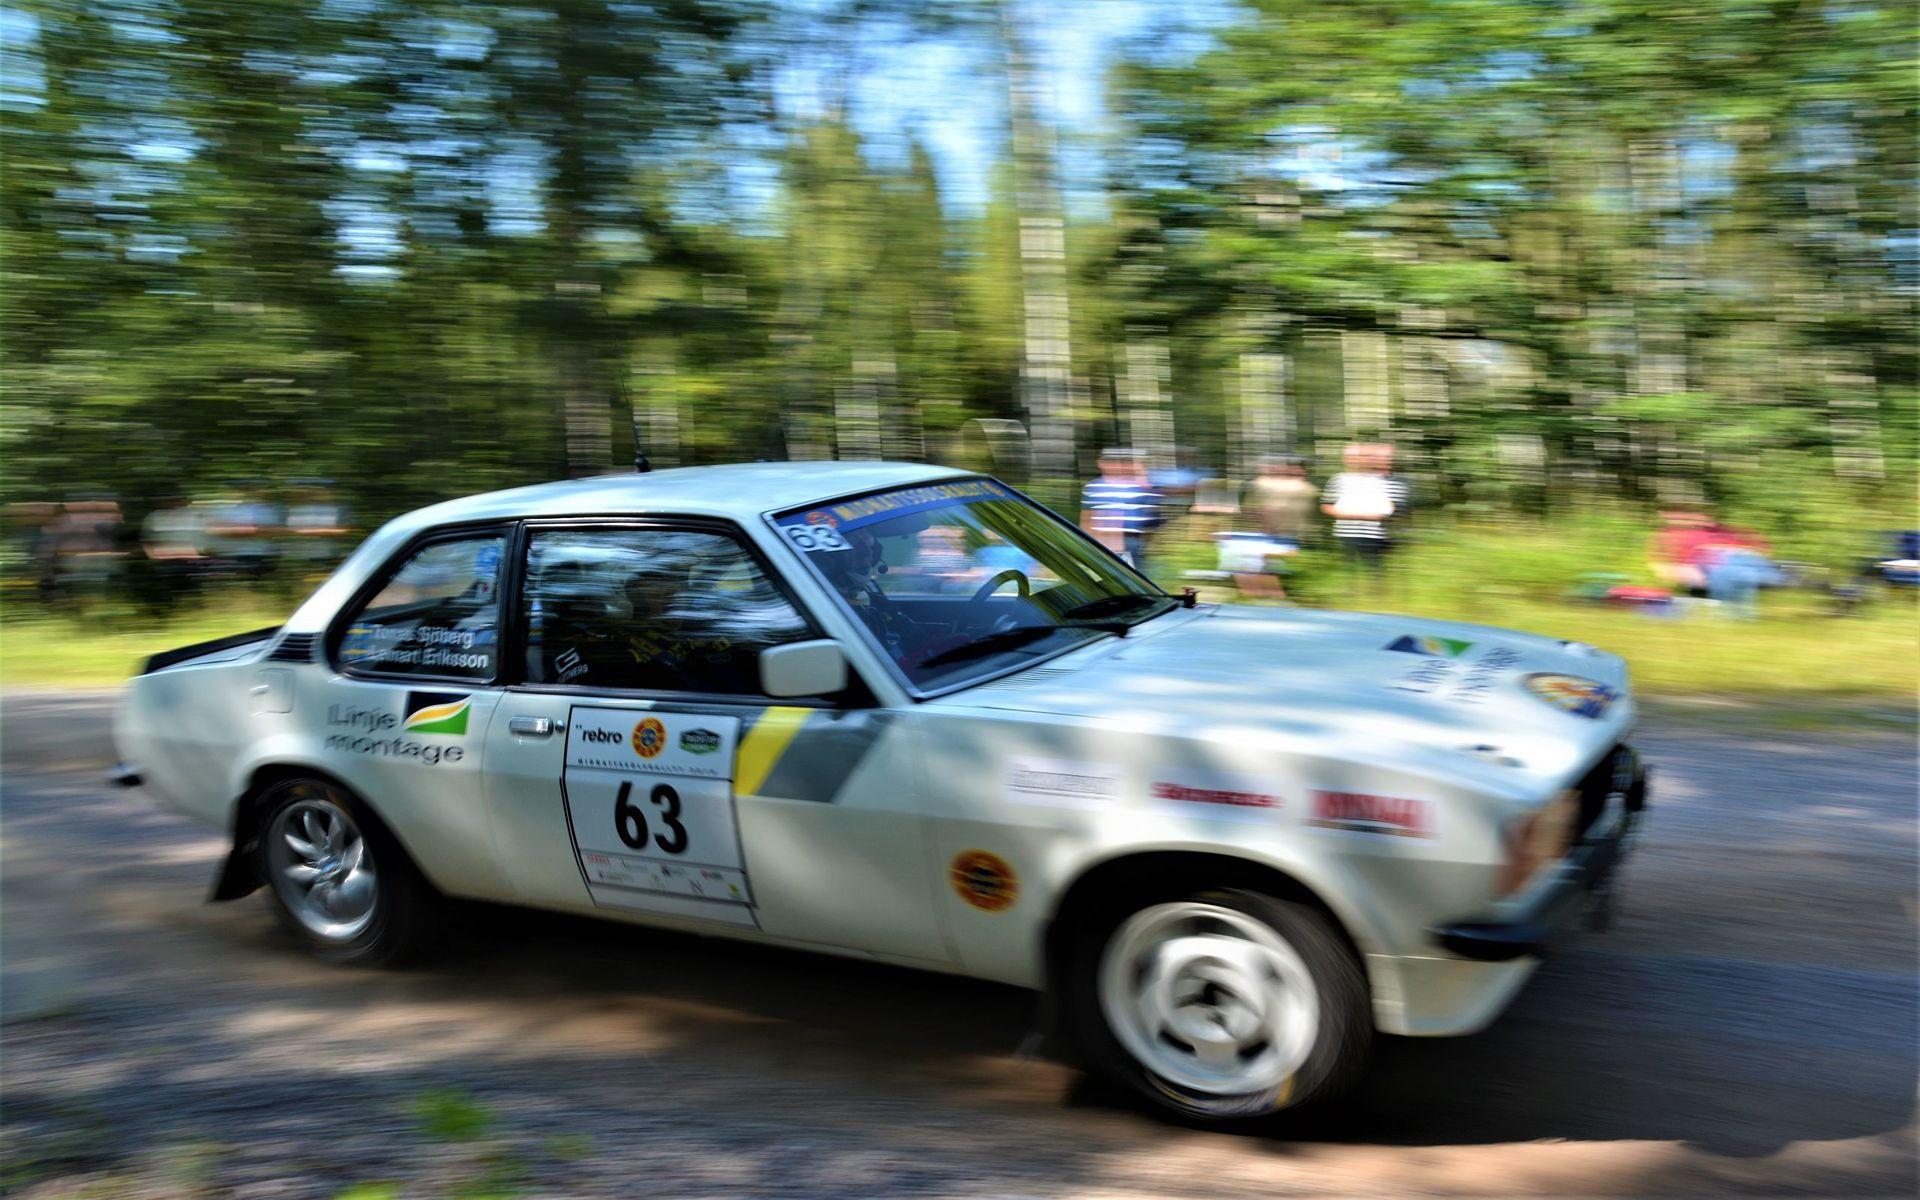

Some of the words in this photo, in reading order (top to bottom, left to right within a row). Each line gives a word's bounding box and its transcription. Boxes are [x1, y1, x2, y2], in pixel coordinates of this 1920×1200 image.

[786, 526, 842, 549] 63
[418, 626, 476, 650] Sjöberg
[422, 648, 490, 669] Eriksson
[328, 704, 397, 733] Linje
[325, 735, 464, 765] montage
[614, 782, 688, 854] 63
